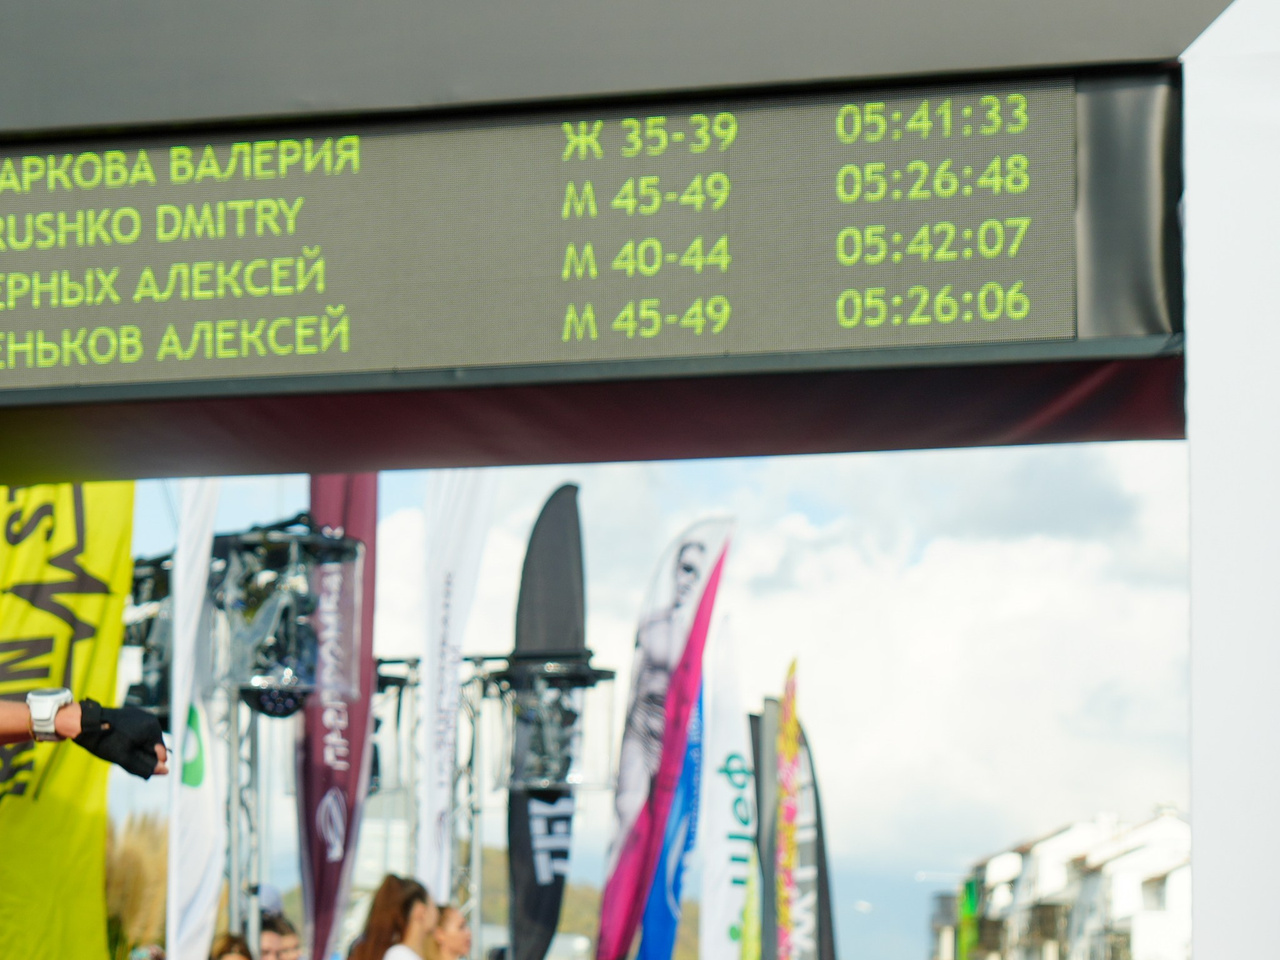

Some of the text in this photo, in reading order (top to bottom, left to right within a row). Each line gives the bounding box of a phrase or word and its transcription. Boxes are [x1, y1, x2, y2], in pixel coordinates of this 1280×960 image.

[171, 136, 361, 184] ВАЛЕРИЯ
[562, 121, 603, 161] Ж
[621, 112, 738, 158] 35-39
[836, 94, 1029, 144] 05:41:33
[157, 198, 304, 241] DMITRY
[611, 171, 732, 216] 45-49
[836, 154, 1029, 203] 05:26:48
[133, 245, 326, 302] АЛЕКСЕЙ
[611, 234, 732, 278] 40-44
[836, 217, 1031, 267] 05:42:07
[157, 304, 350, 361] АЛЕКСЕЙ
[611, 295, 732, 338] 45-49
[836, 280, 1030, 329] 05:26:06
